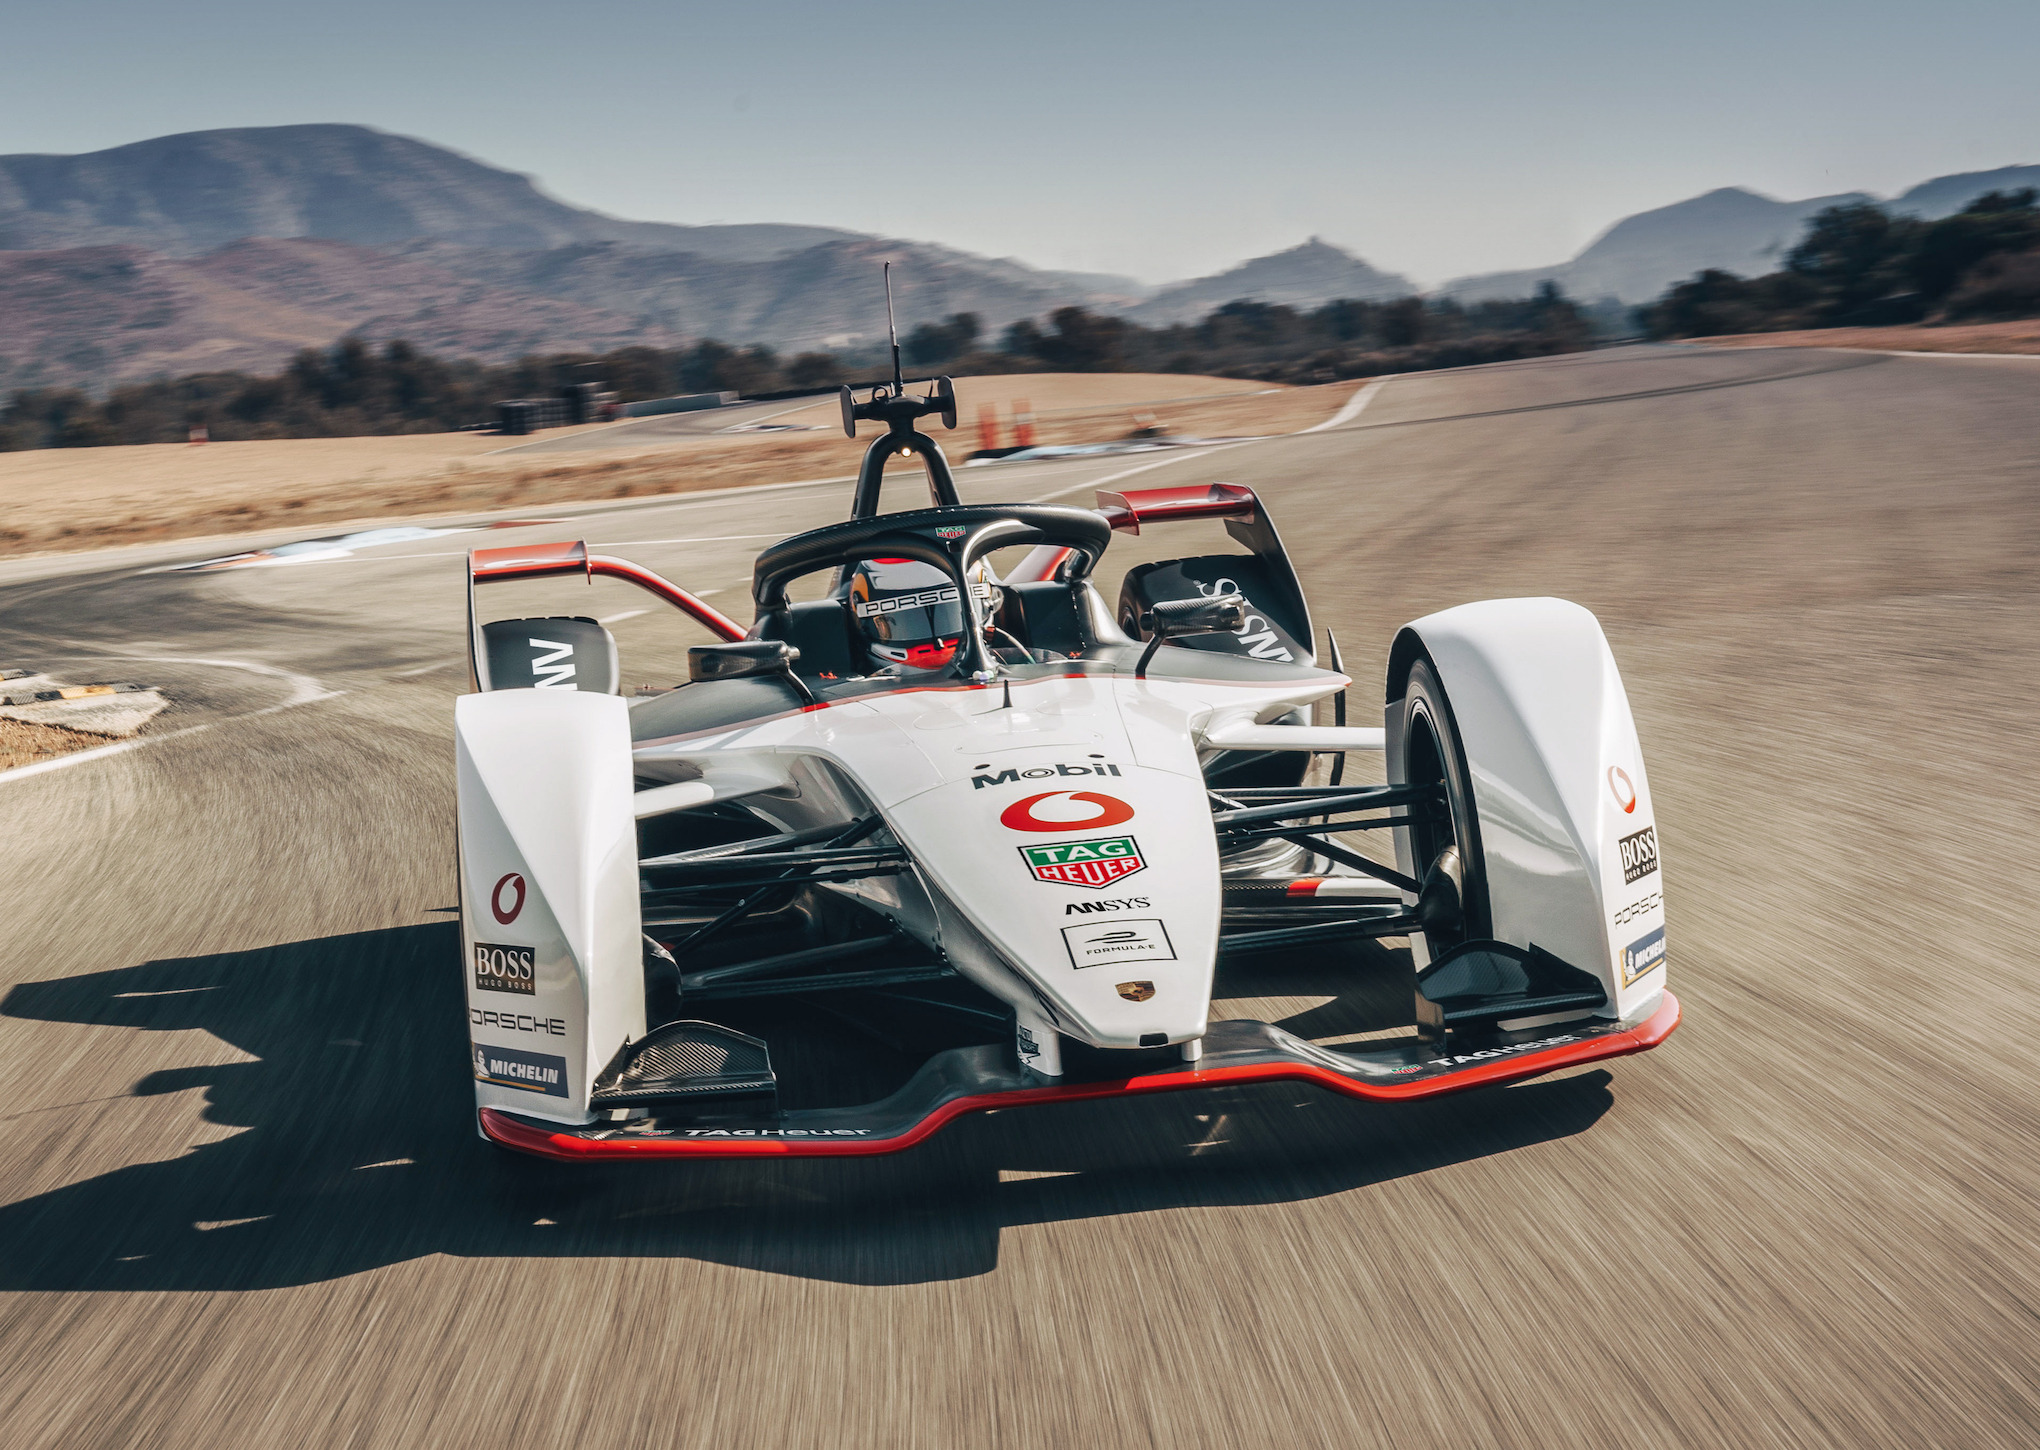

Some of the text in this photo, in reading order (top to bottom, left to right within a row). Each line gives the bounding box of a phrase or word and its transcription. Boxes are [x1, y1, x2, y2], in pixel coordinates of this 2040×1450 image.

[865, 585, 984, 615] PORSCE
[1196, 578, 1294, 662] NSS
[971, 763, 1122, 790] Mobil
[1033, 841, 1128, 862] TAG
[1621, 831, 1656, 870] BOSS
[1040, 858, 1136, 884] HEUER
[1065, 897, 1150, 915] ANSYS
[476, 947, 532, 980] BOSS
[478, 979, 532, 990] HUGO BOSS
[470, 1008, 566, 1036] ORSCHE
[490, 1059, 558, 1084] MICHELIN
